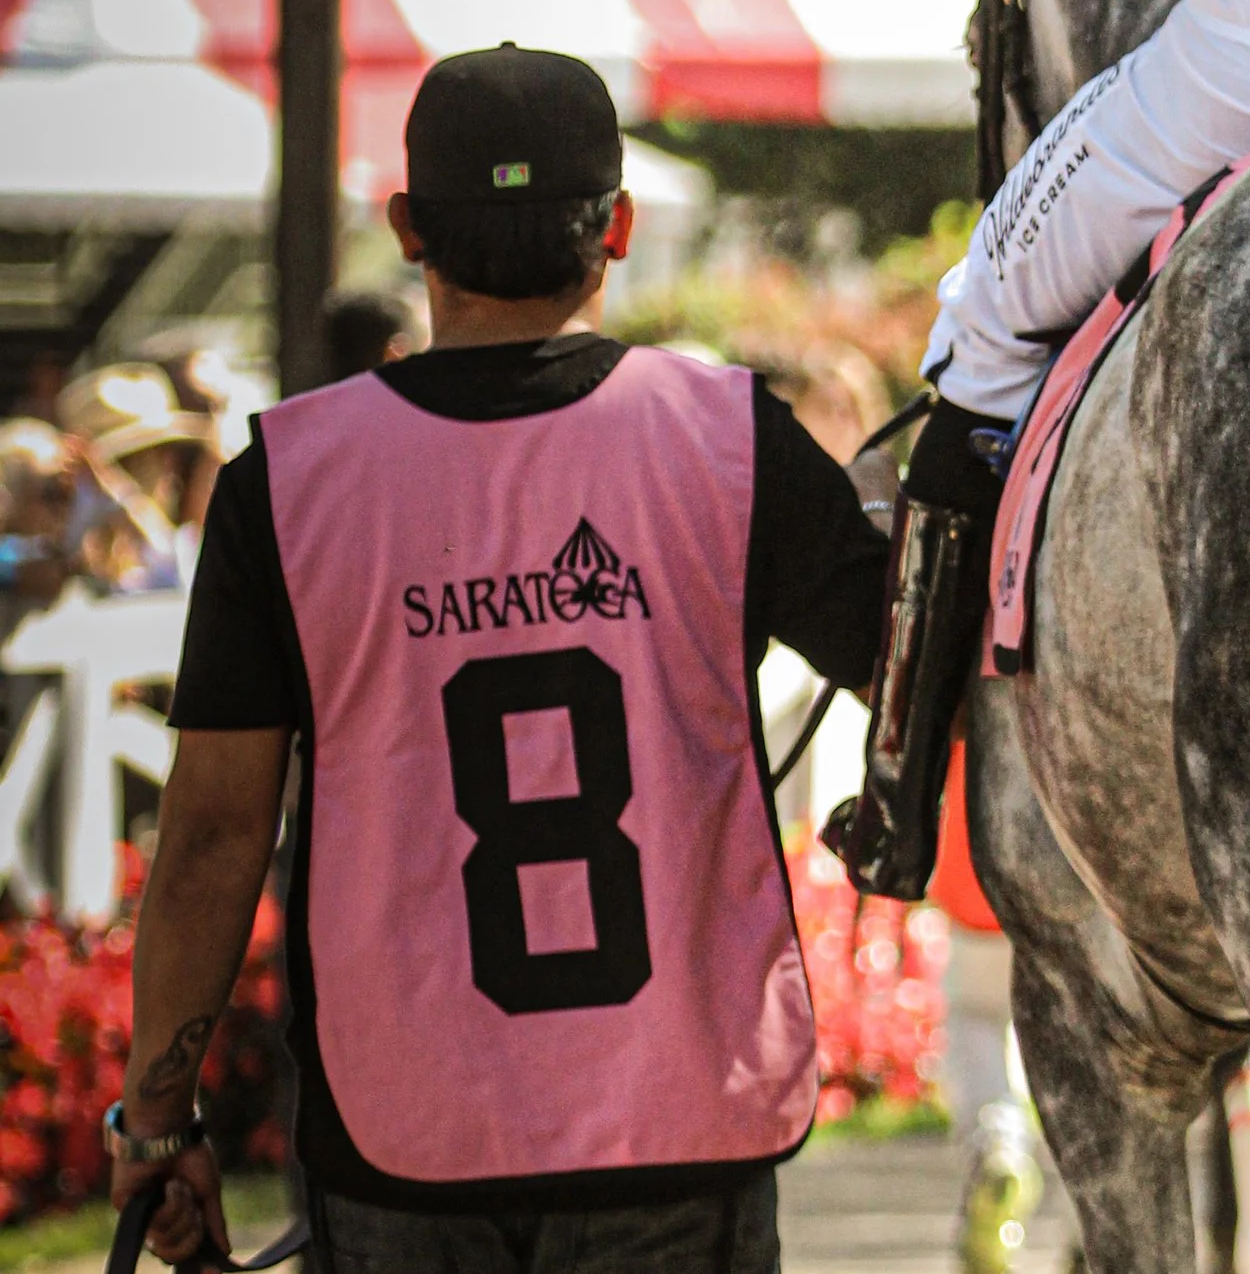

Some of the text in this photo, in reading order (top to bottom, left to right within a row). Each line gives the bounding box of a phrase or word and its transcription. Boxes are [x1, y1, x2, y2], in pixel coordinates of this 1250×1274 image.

[1017, 144, 1090, 253] ICE CREAM
[402, 565, 653, 639] SARATOGA
[440, 645, 653, 1017] 8
